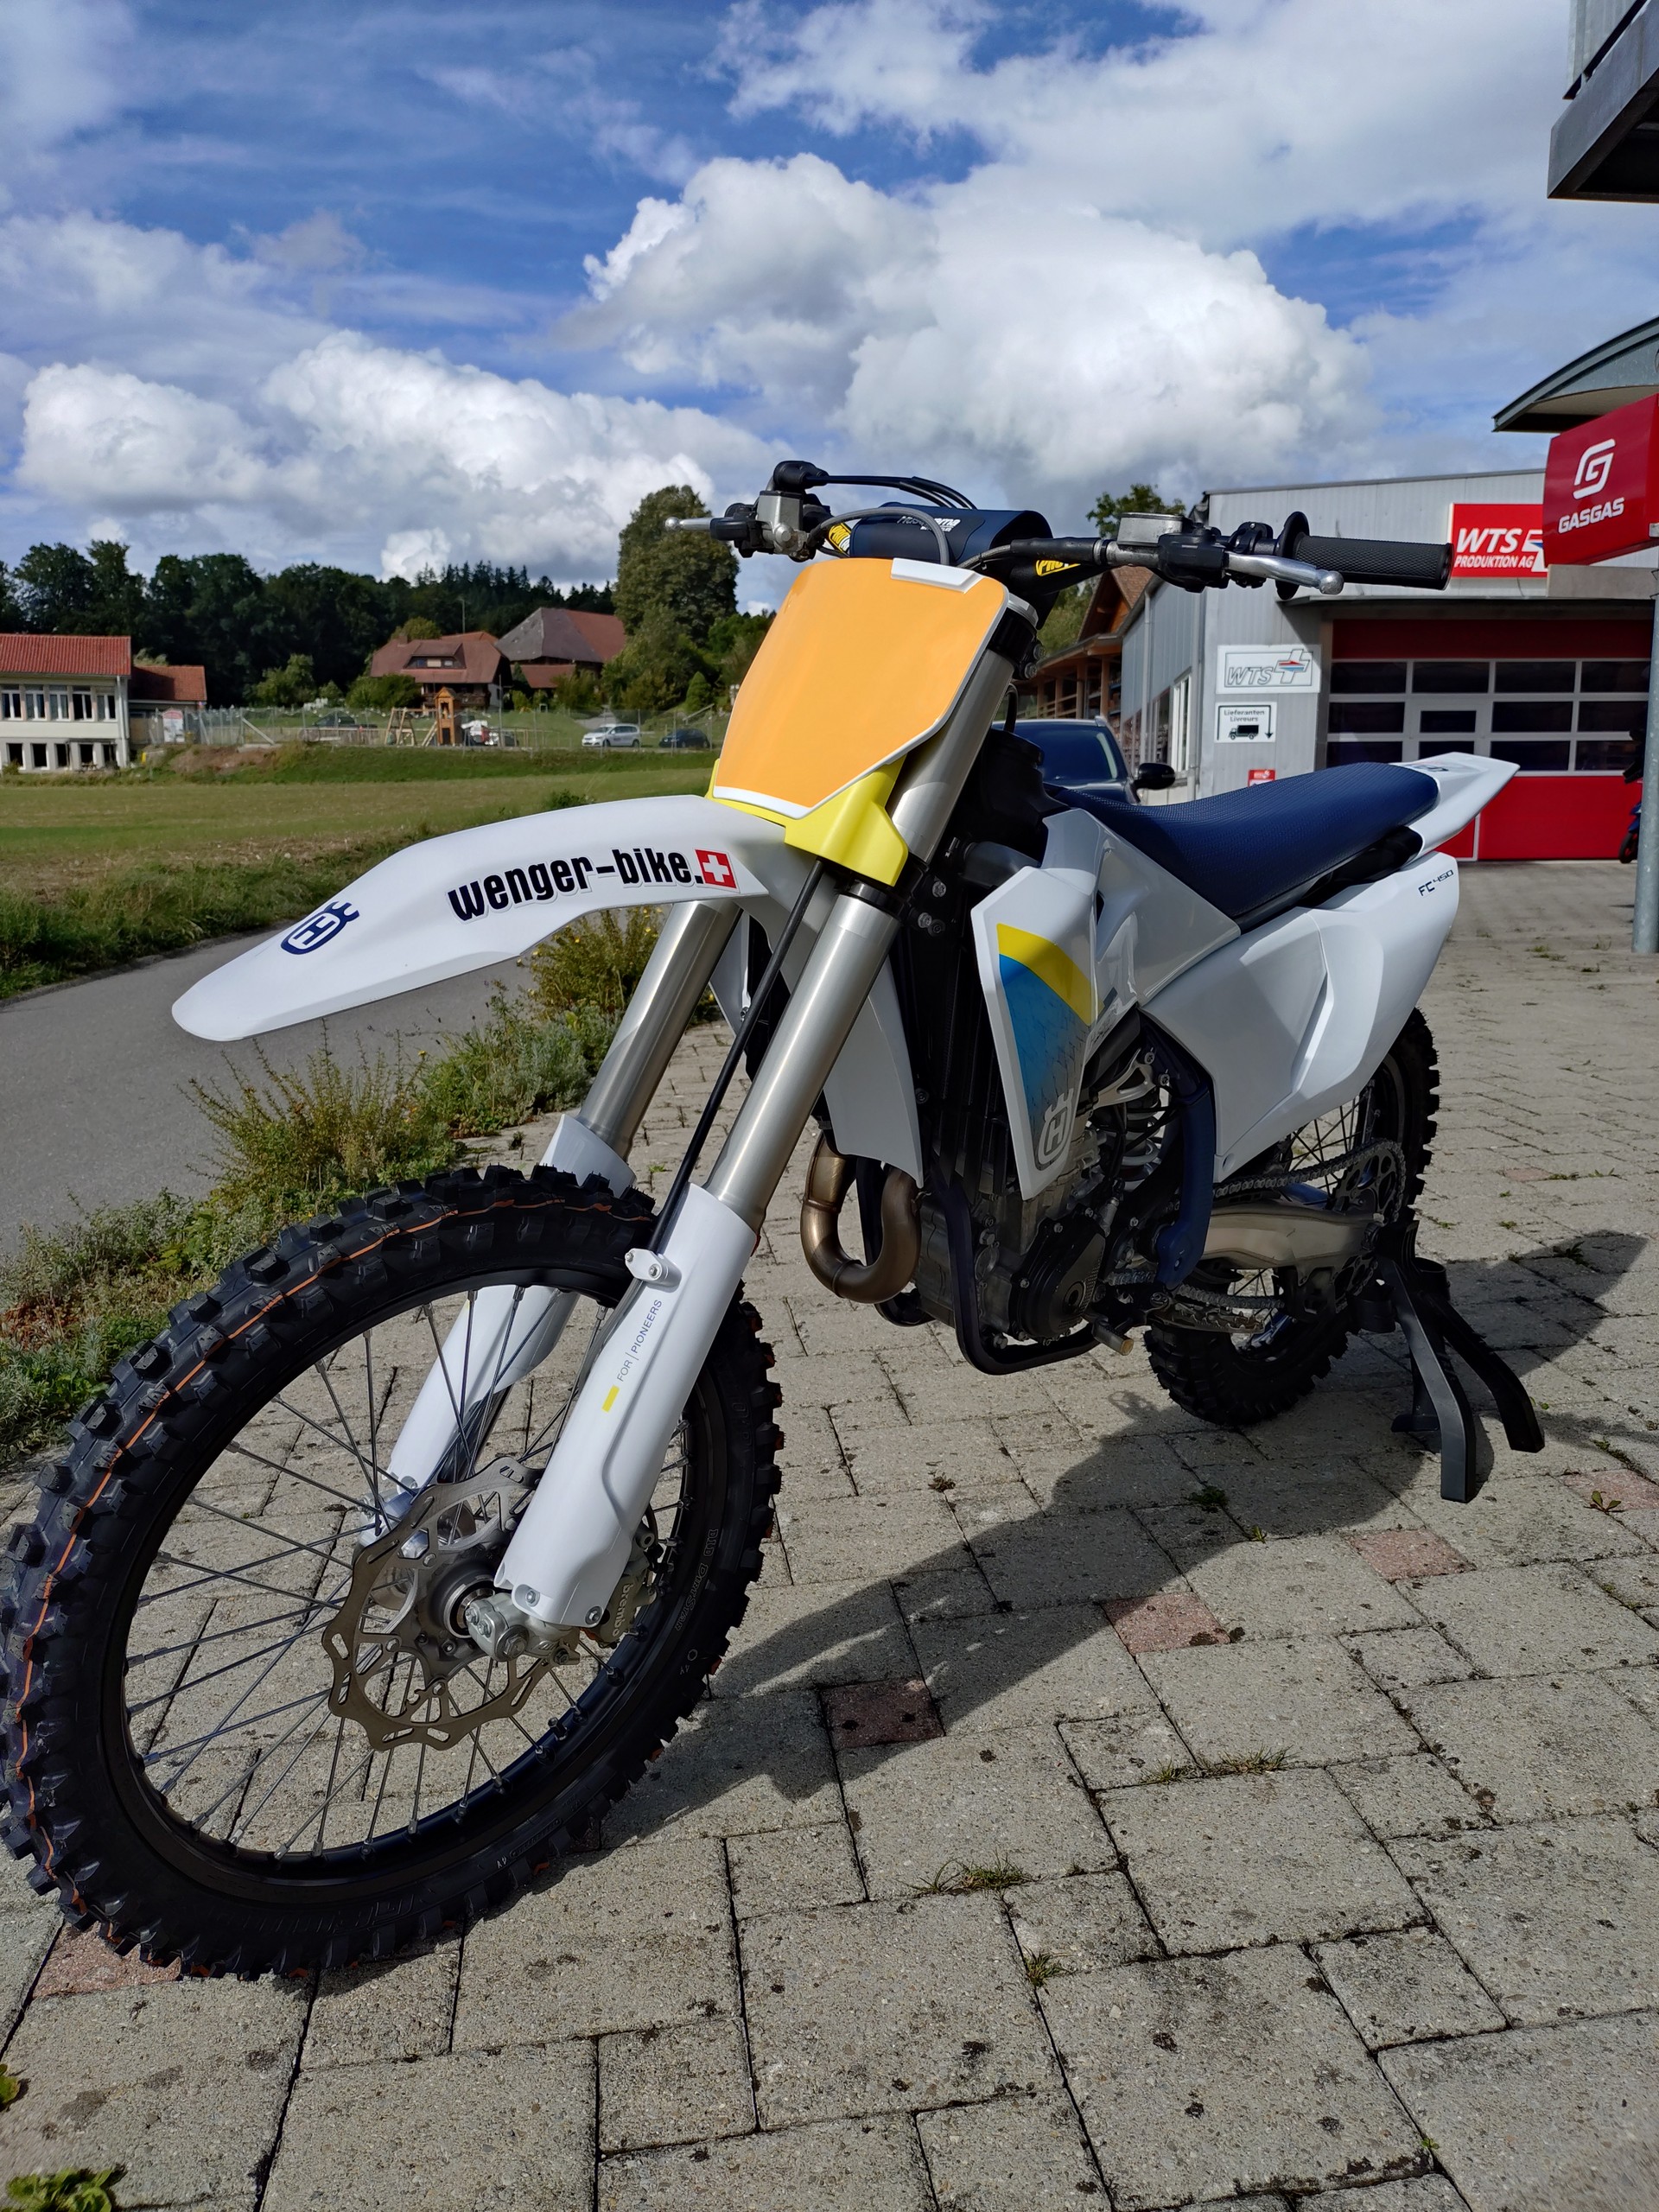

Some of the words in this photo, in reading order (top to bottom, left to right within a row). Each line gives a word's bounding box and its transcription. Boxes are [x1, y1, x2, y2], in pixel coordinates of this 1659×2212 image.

[1558, 497, 1625, 534] GASGAS
[1456, 527, 1523, 554] WTS
[1453, 555, 1518, 569] PRODUKTION
[1518, 555, 1535, 569] AG
[1227, 666, 1274, 686] WTS
[1418, 880, 1435, 897] FC
[1433, 869, 1454, 883] 450
[616, 1359, 633, 1382] FOR
[630, 1299, 663, 1354] PIONEERS
[612, 1583, 634, 1637] brembo
